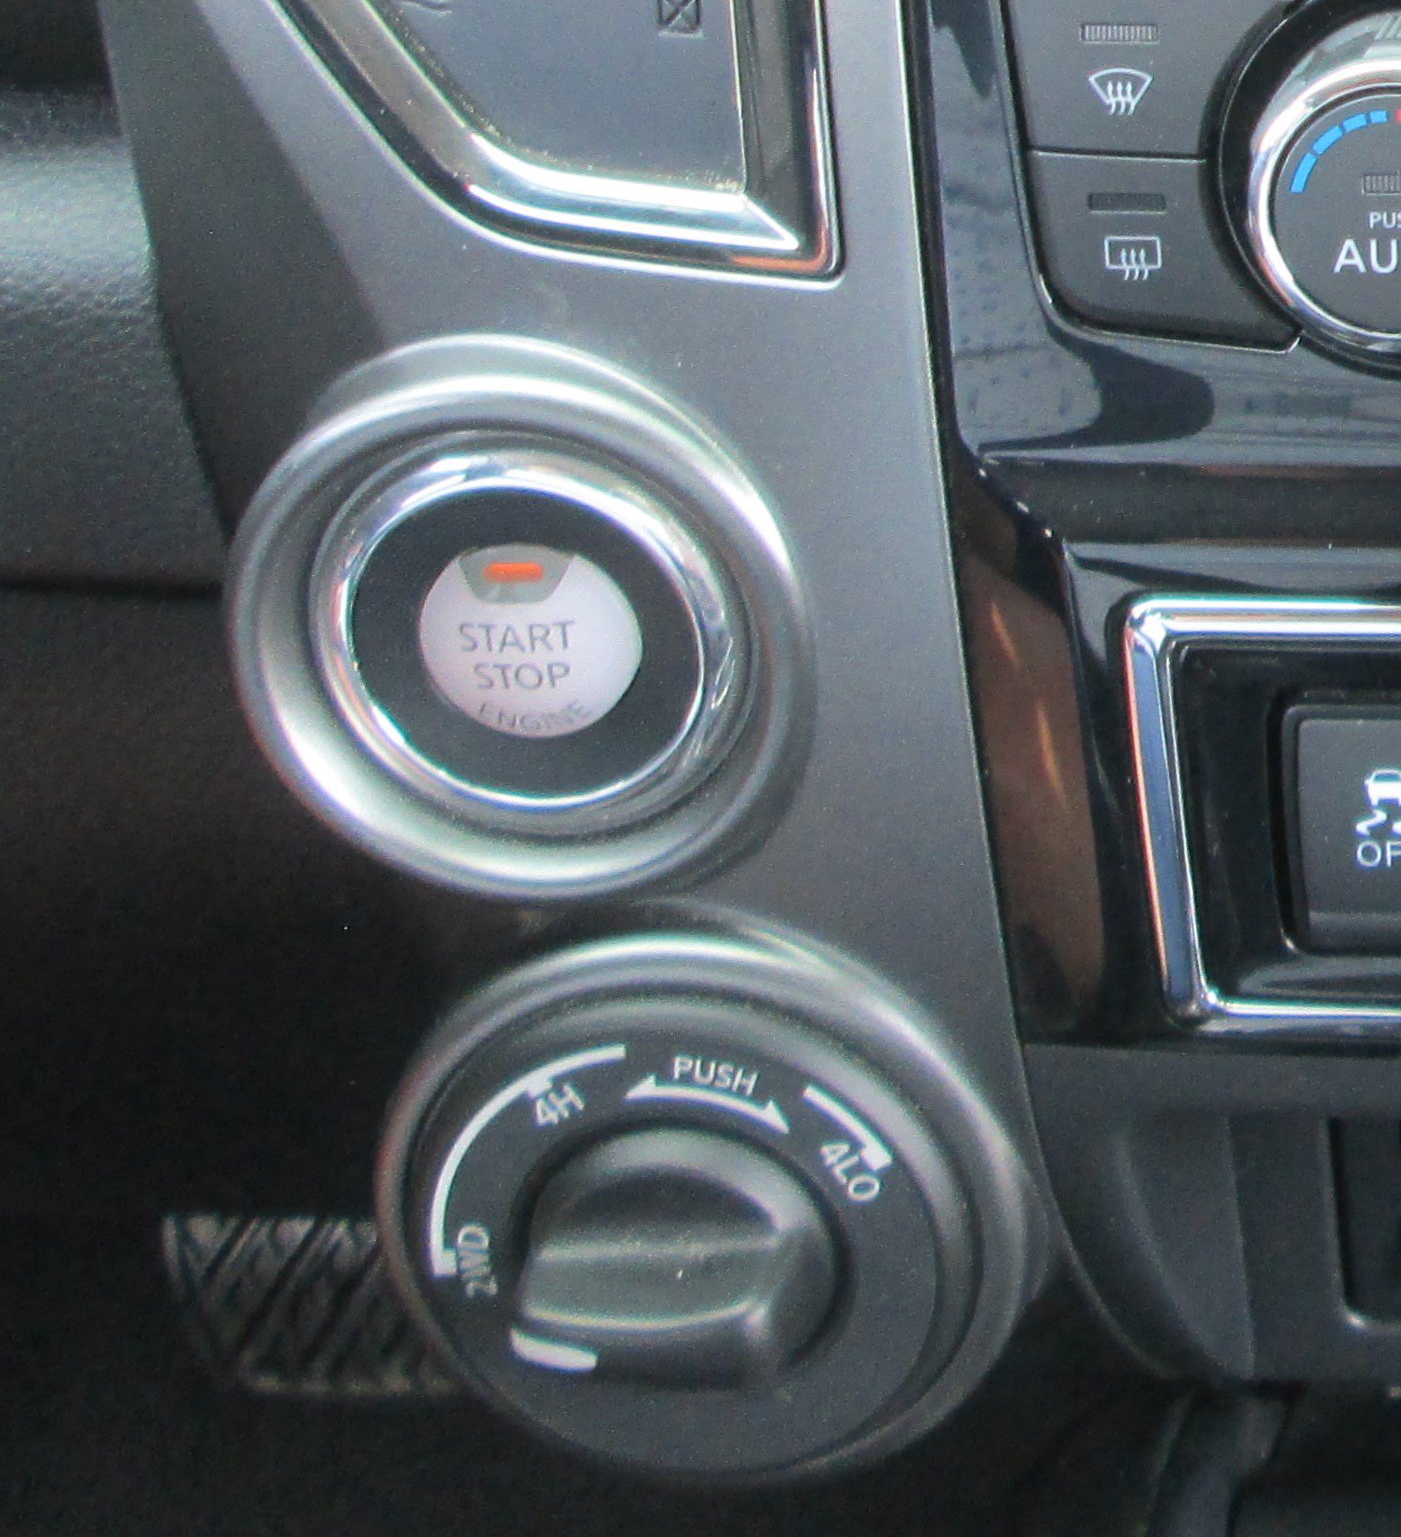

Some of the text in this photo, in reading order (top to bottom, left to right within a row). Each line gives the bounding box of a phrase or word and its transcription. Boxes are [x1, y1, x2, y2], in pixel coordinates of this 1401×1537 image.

[459, 620, 575, 653] START
[473, 662, 570, 690] STOP
[673, 1054, 759, 1096] PUSH
[533, 1082, 585, 1128] 4H
[819, 1141, 881, 1204] 4LO
[457, 1225, 498, 1300] 2WD
